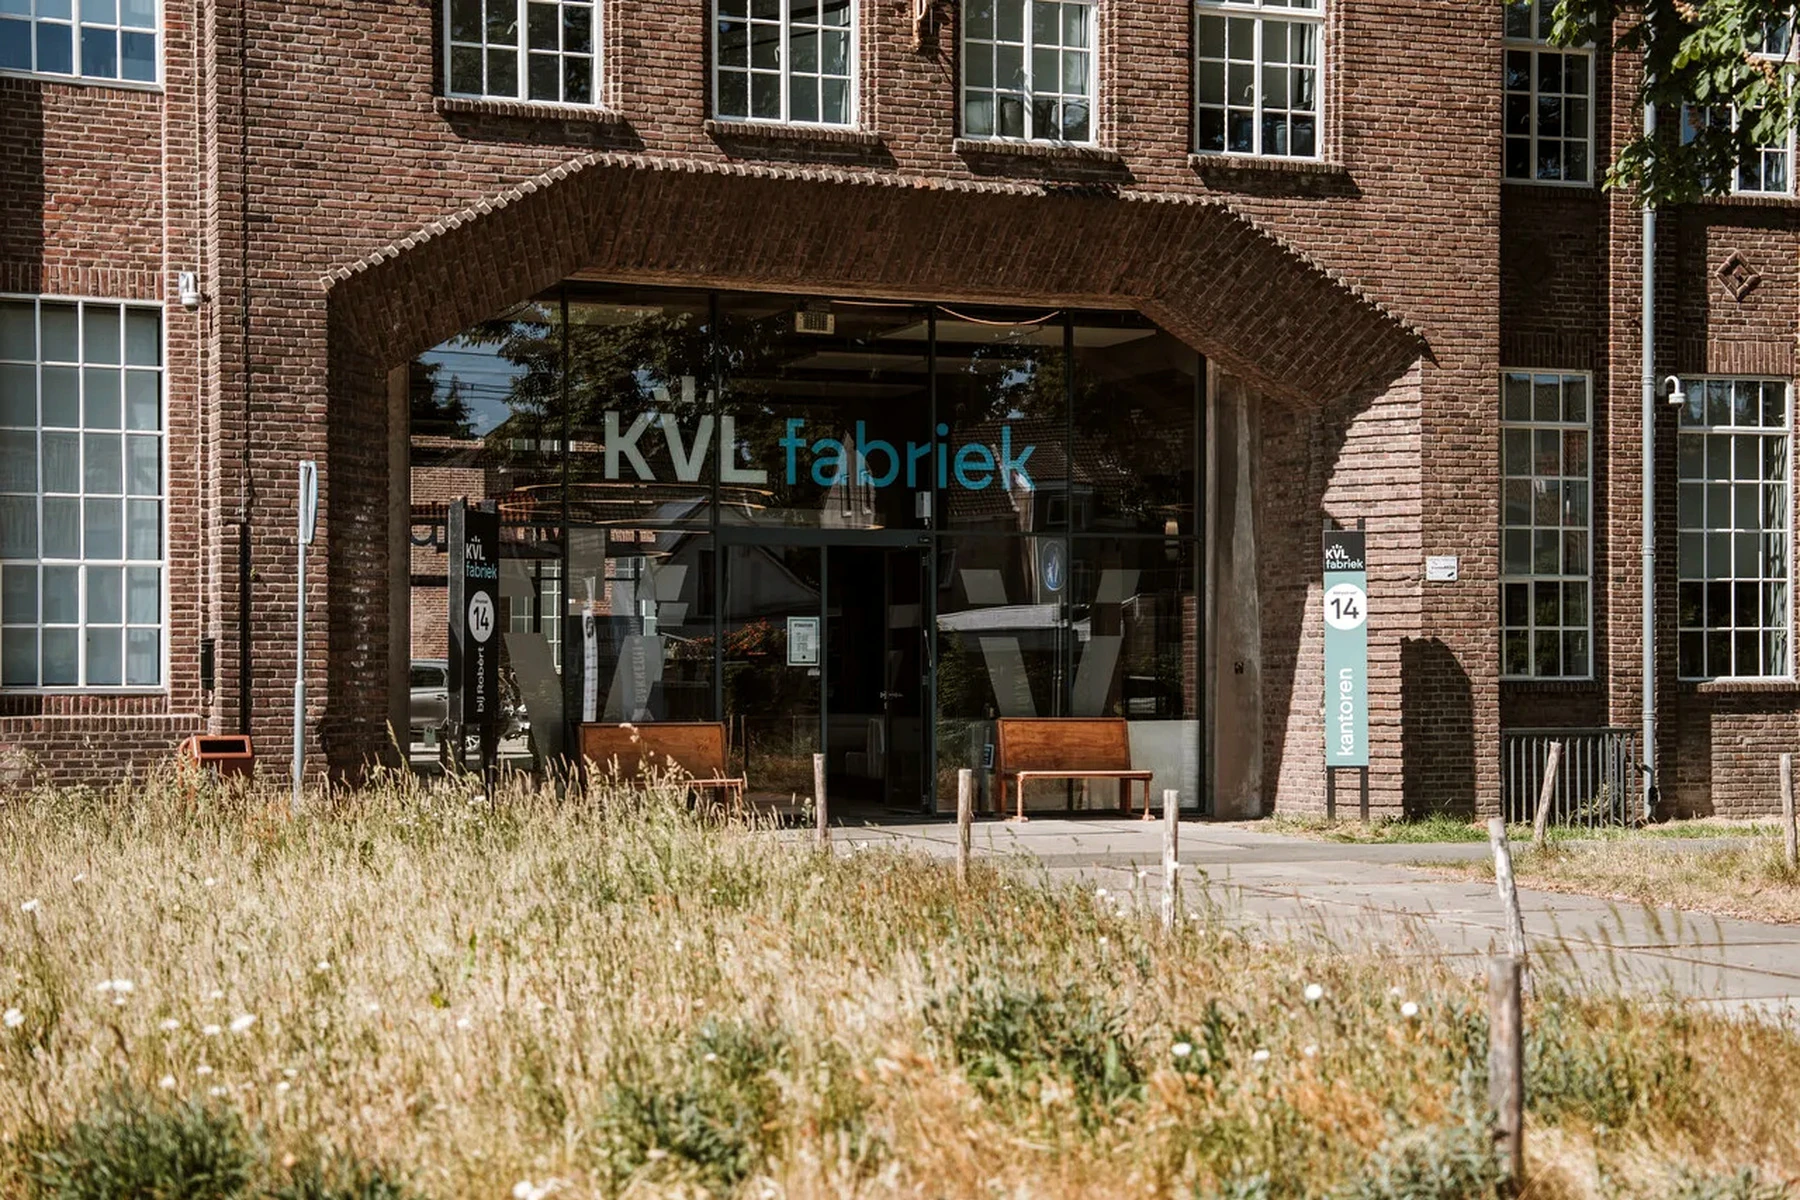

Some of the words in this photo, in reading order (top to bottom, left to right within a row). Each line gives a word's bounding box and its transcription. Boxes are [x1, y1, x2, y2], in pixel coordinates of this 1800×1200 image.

[604, 410, 768, 484] KVL
[779, 417, 1037, 491] fabriek
[466, 543, 486, 560] KVL
[1325, 548, 1349, 559] KVL
[466, 561, 497, 579] fabriek
[1326, 559, 1364, 570] fabriek
[473, 606, 489, 631] 14
[1330, 597, 1360, 620] 14
[1336, 667, 1354, 756] kantoren
